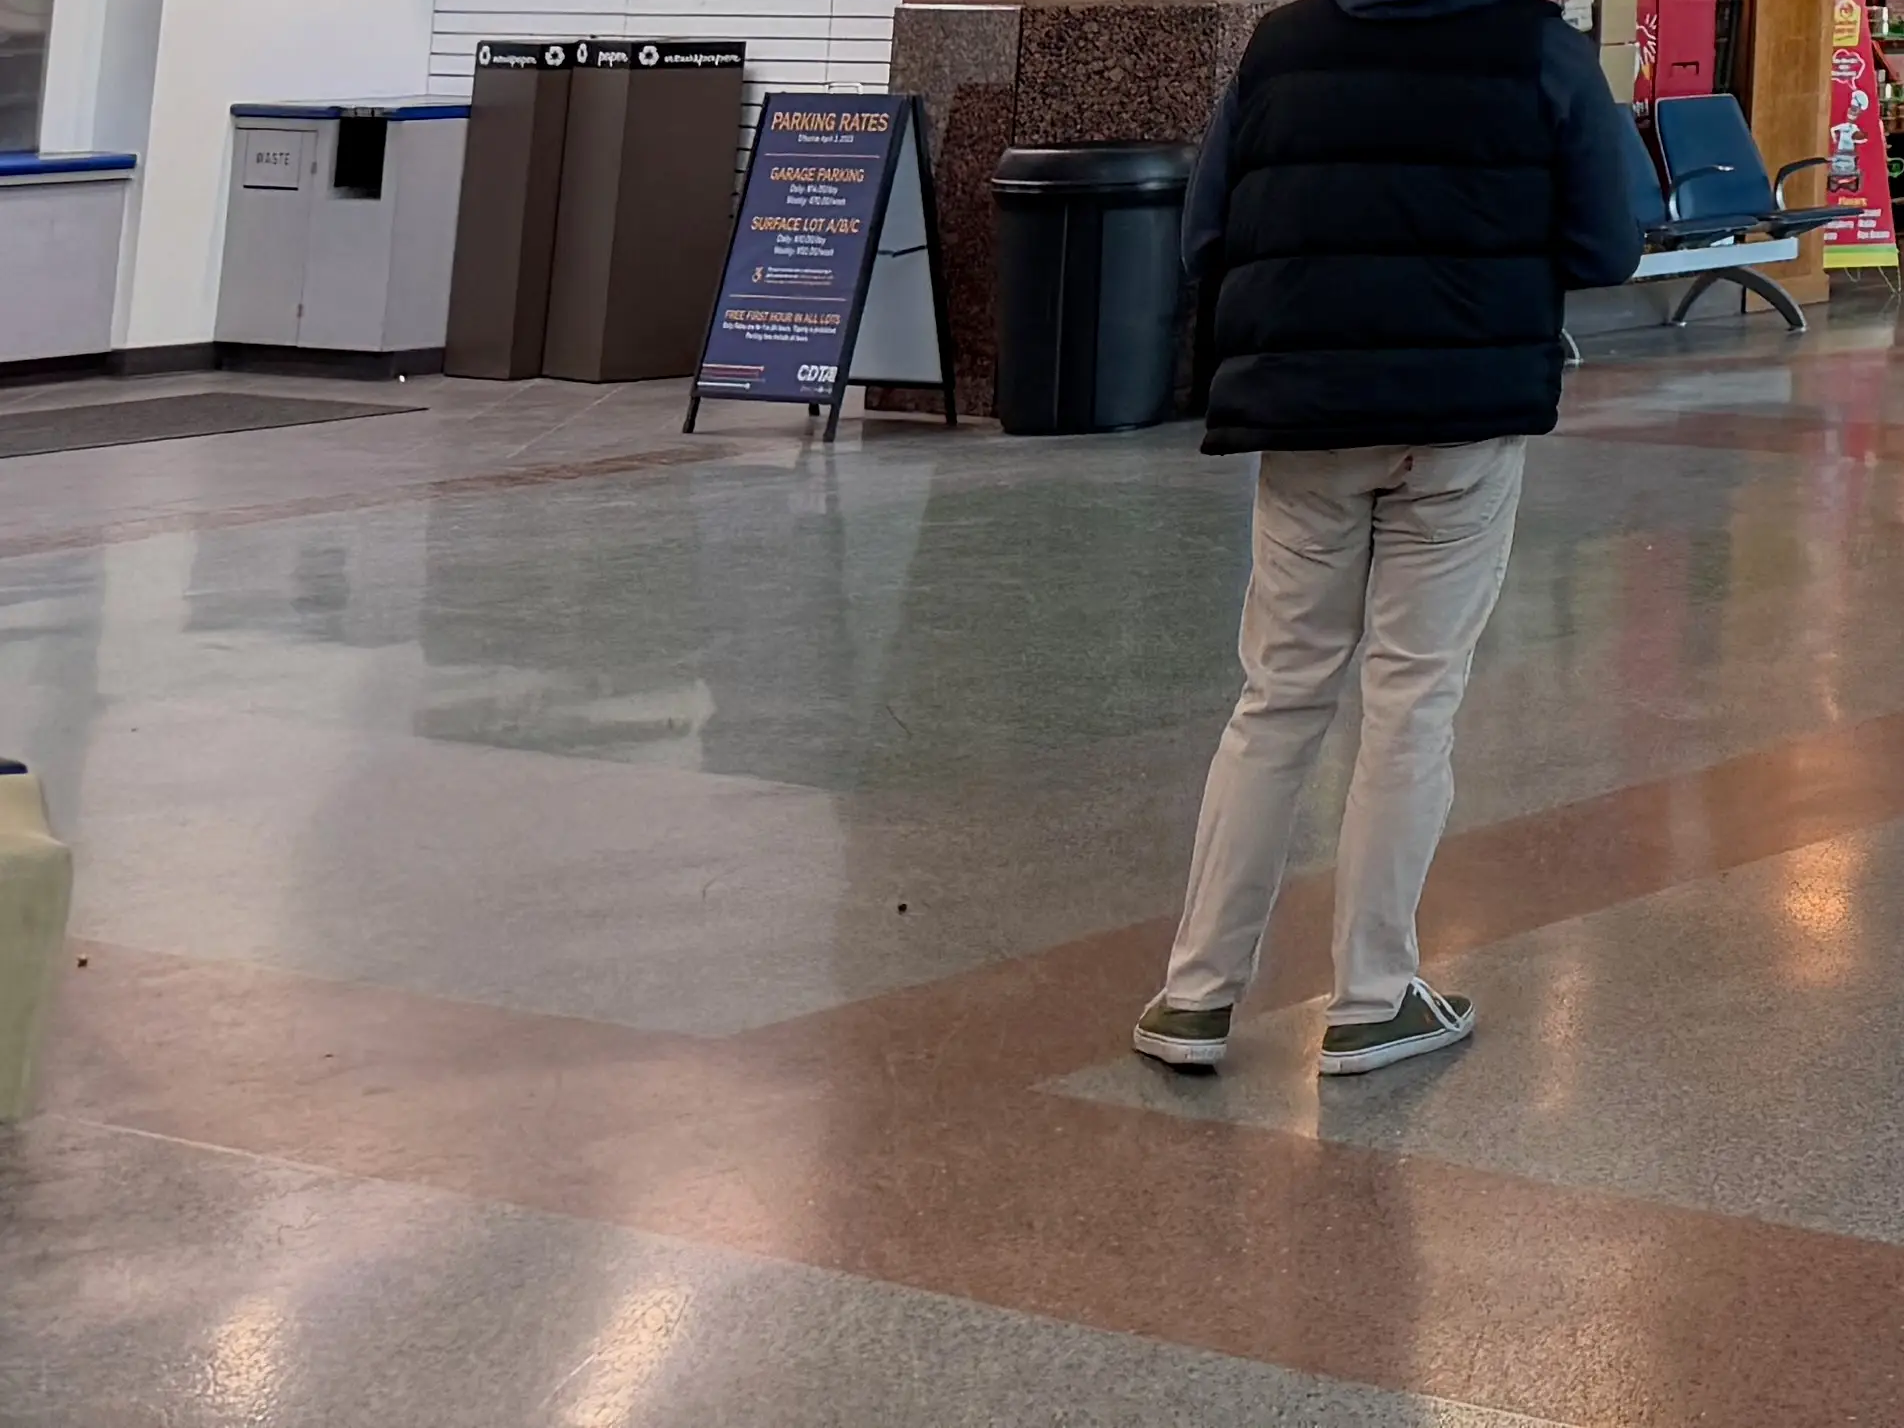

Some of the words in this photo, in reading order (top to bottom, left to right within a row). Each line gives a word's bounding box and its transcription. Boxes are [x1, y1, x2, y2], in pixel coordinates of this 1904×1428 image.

[597, 49, 630, 67] paper
[770, 111, 837, 133] PARKING
[838, 112, 891, 133] RATES
[770, 166, 817, 183] GARAGE
[816, 167, 866, 184] PARKING
[750, 215, 803, 232] SURFACE
[802, 217, 827, 232] LOT
[797, 363, 838, 383] CDTA
